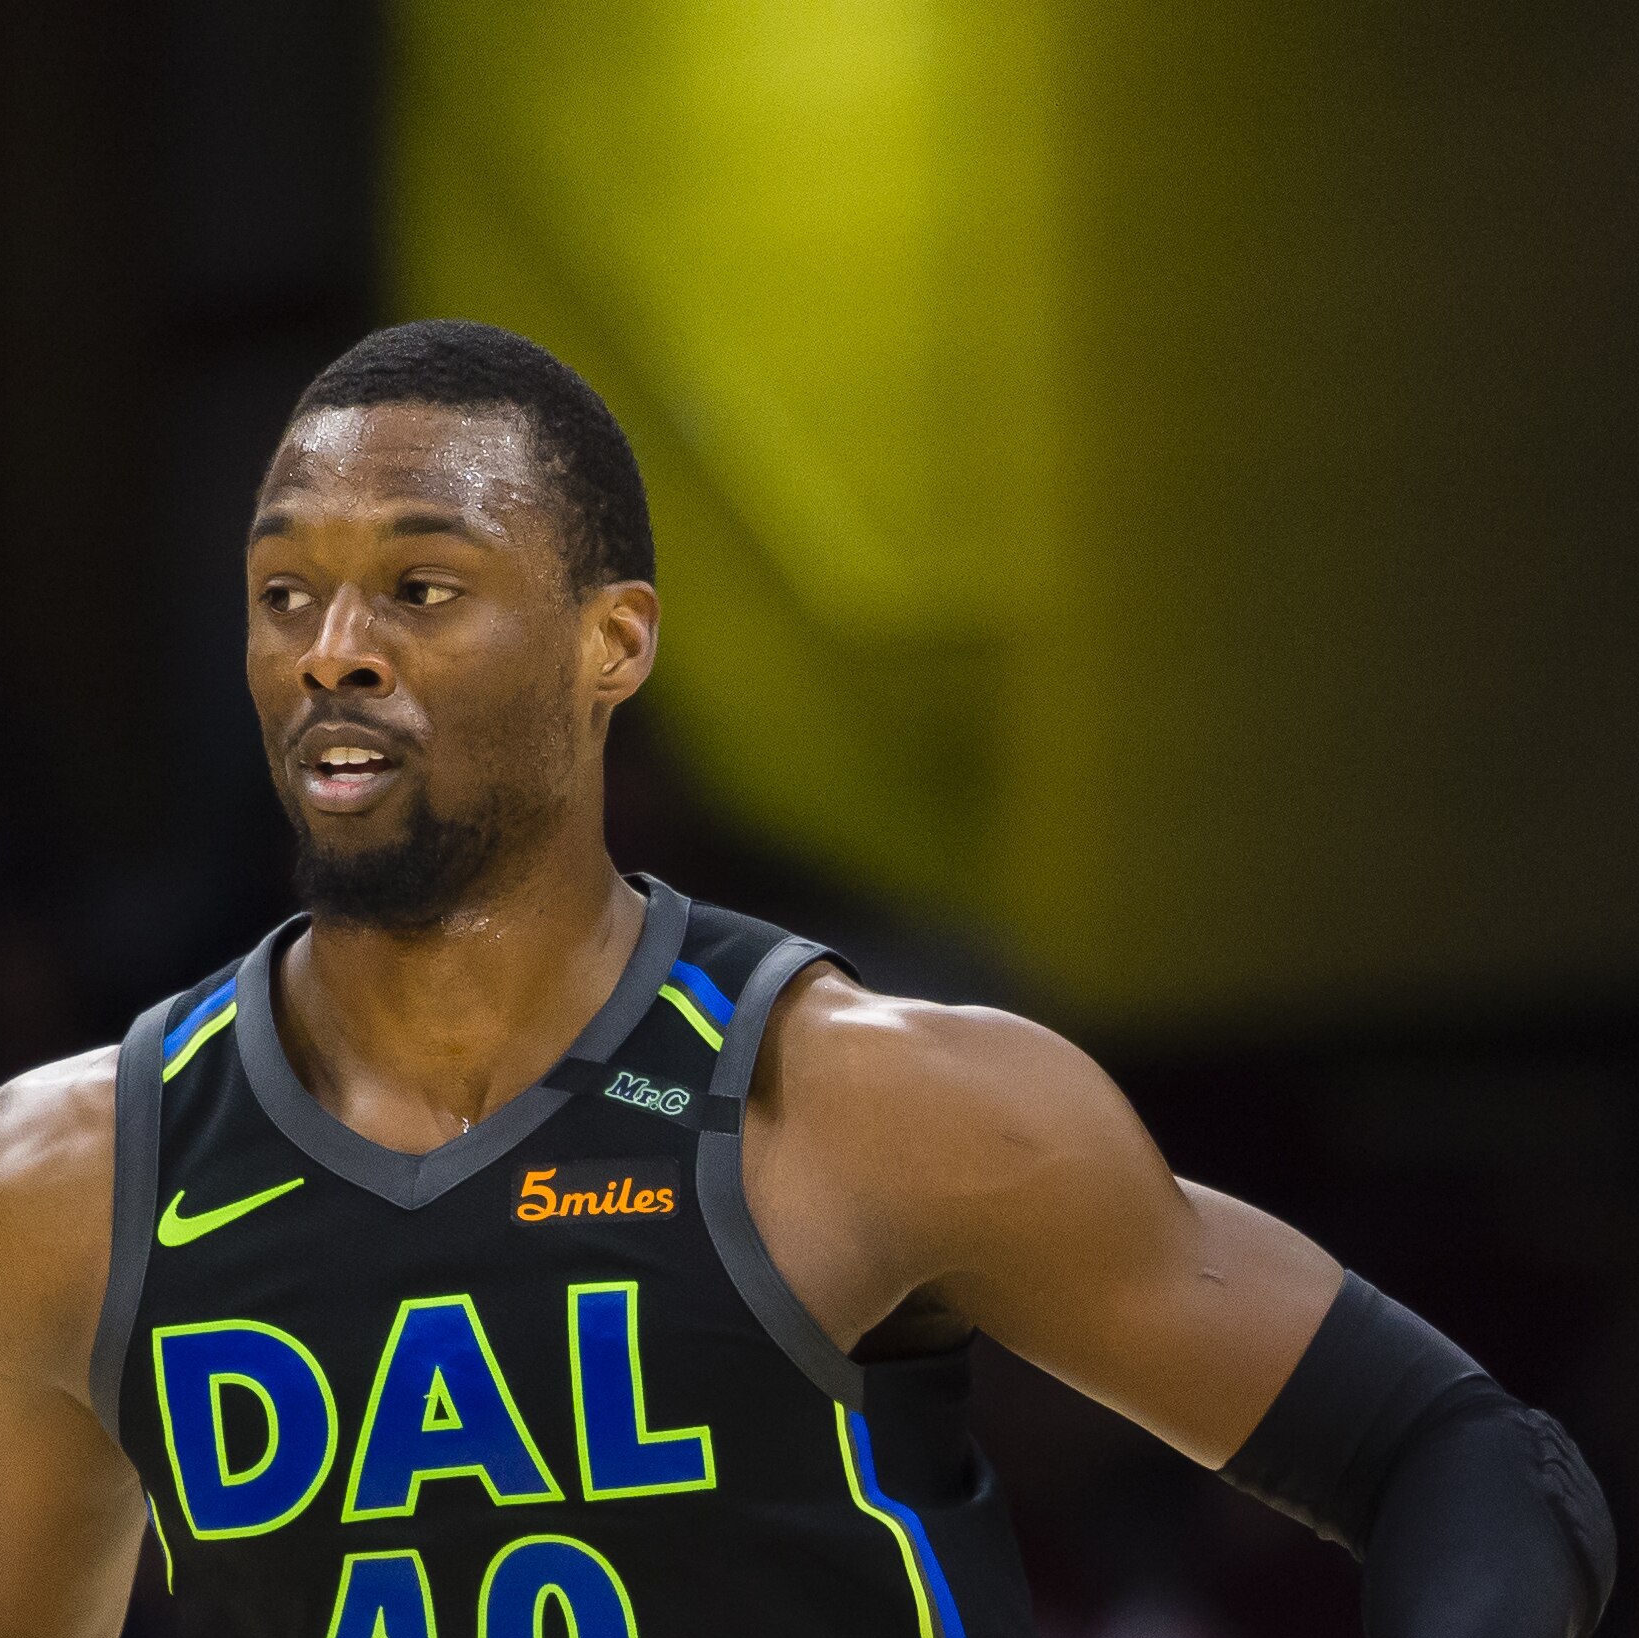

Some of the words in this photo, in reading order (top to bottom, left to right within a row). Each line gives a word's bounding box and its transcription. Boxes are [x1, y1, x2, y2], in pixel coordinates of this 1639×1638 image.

[605, 1072, 690, 1115] Mr.C
[517, 1168, 674, 1221] 5miles
[152, 1281, 716, 1540] DAL
